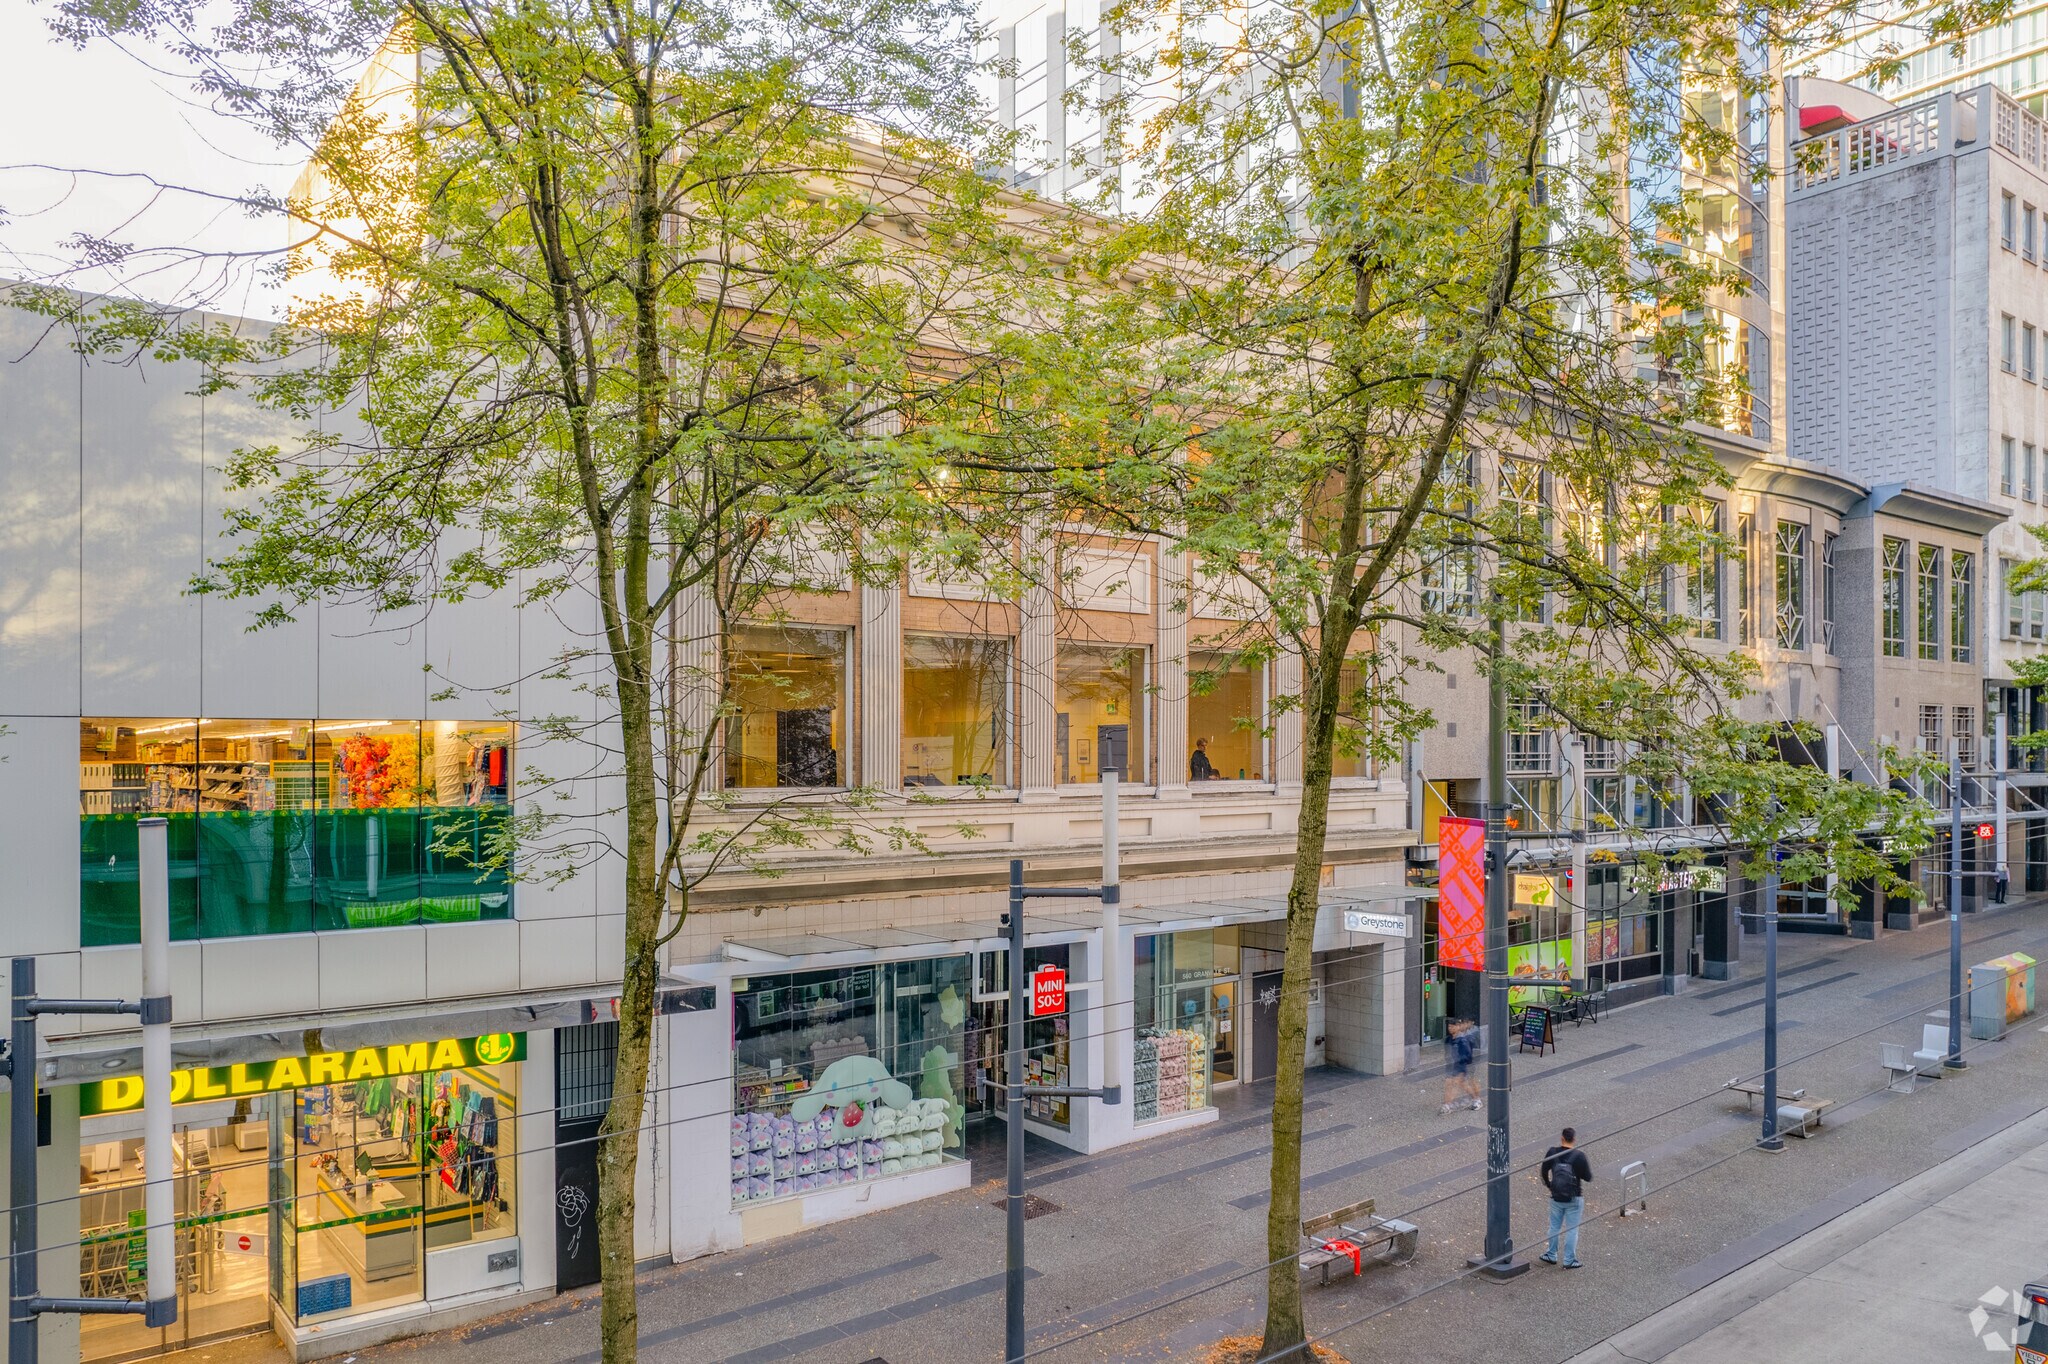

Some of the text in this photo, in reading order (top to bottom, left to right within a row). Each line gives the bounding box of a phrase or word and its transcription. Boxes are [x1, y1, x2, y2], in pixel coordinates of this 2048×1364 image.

[1360, 916, 1404, 929] Greystone
[1193, 968, 1222, 978] GRANVLE
[1037, 979, 1062, 993] MINI
[2021, 1350, 2043, 1361] YIELD
